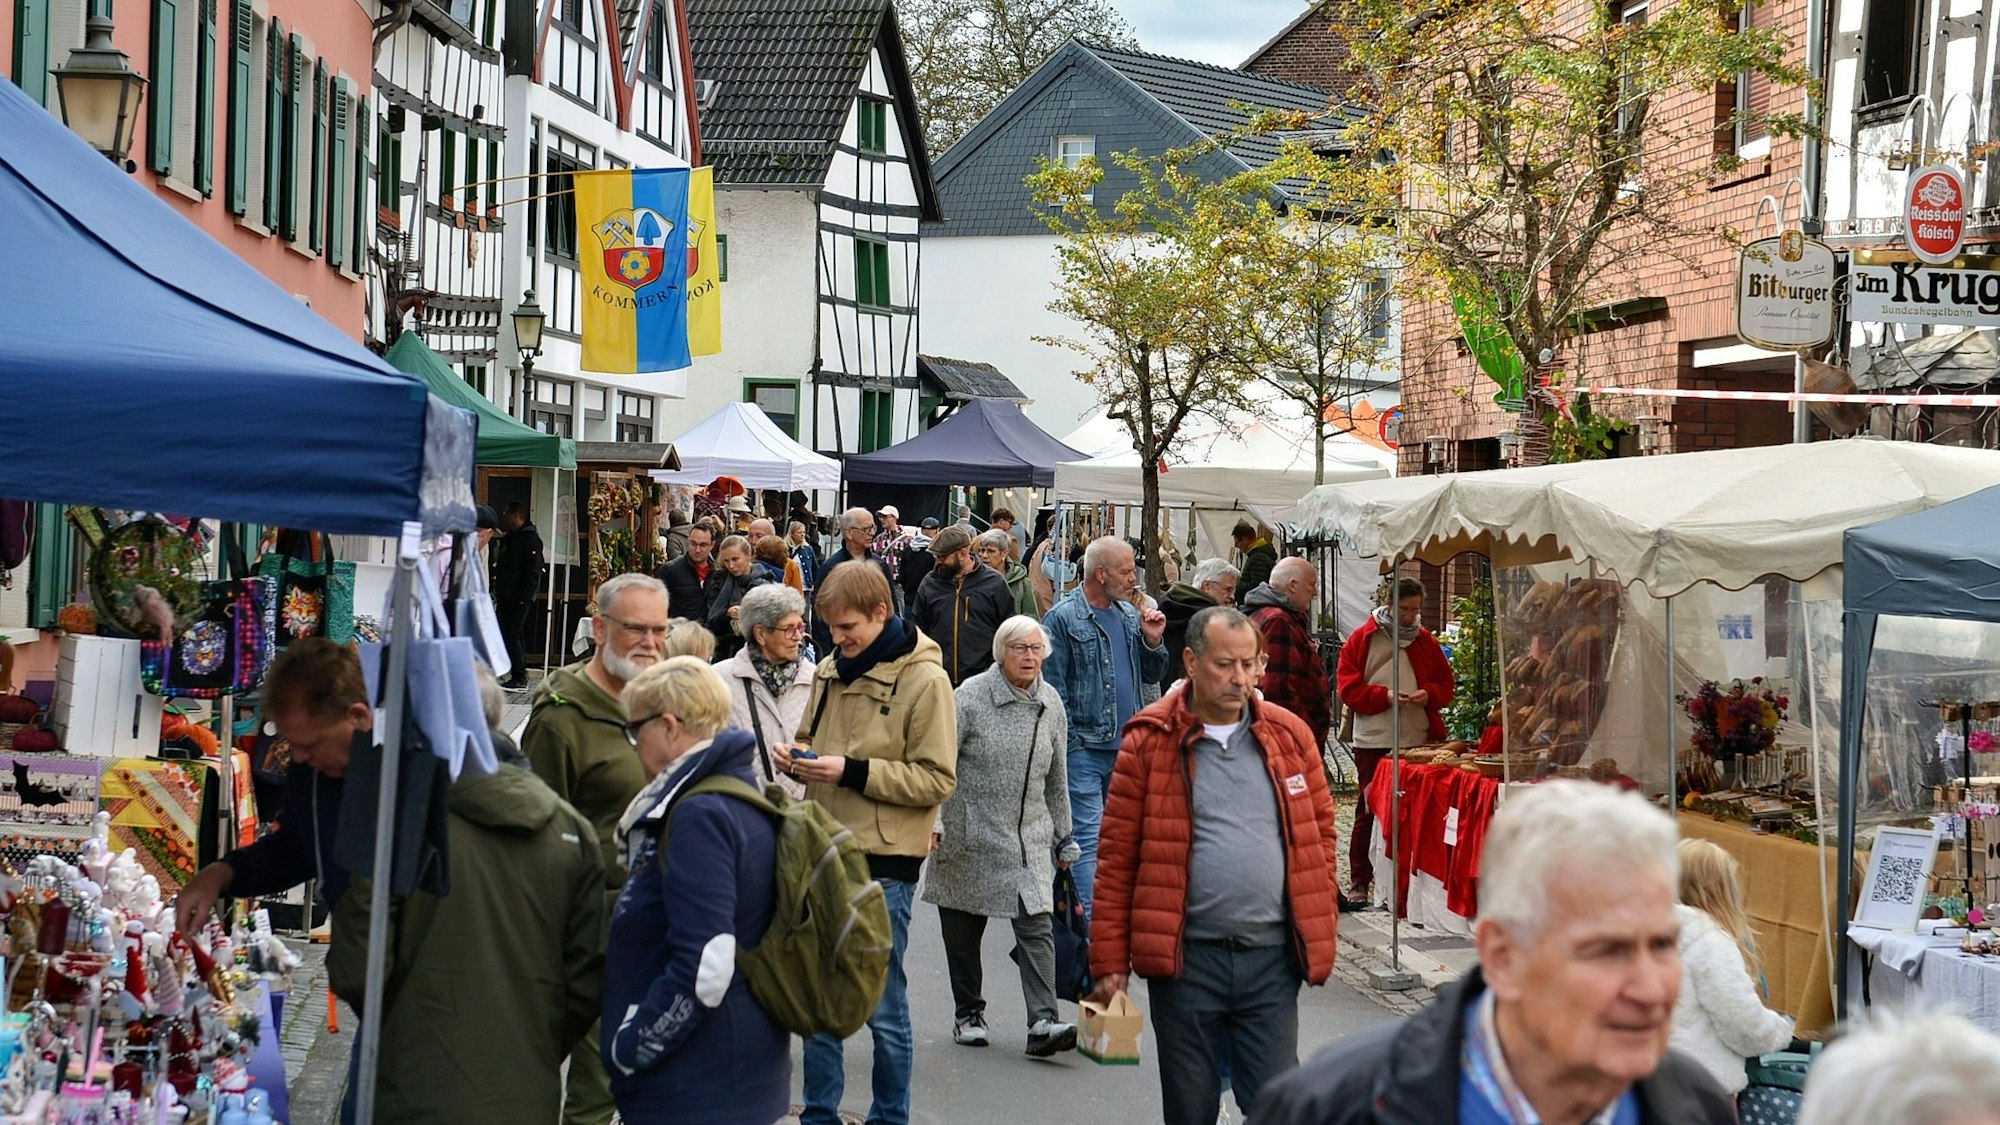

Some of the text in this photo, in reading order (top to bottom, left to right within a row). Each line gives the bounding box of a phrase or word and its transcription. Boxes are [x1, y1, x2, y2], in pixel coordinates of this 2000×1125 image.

[1911, 205, 1962, 222] Reissdorf
[1918, 223, 1954, 242] Kölsch
[592, 280, 678, 310] KOMMERN
[1747, 273, 1829, 305] Bitburger
[1890, 262, 2000, 315] Krug
[1881, 305, 1973, 318] Bundeskegelbahn
